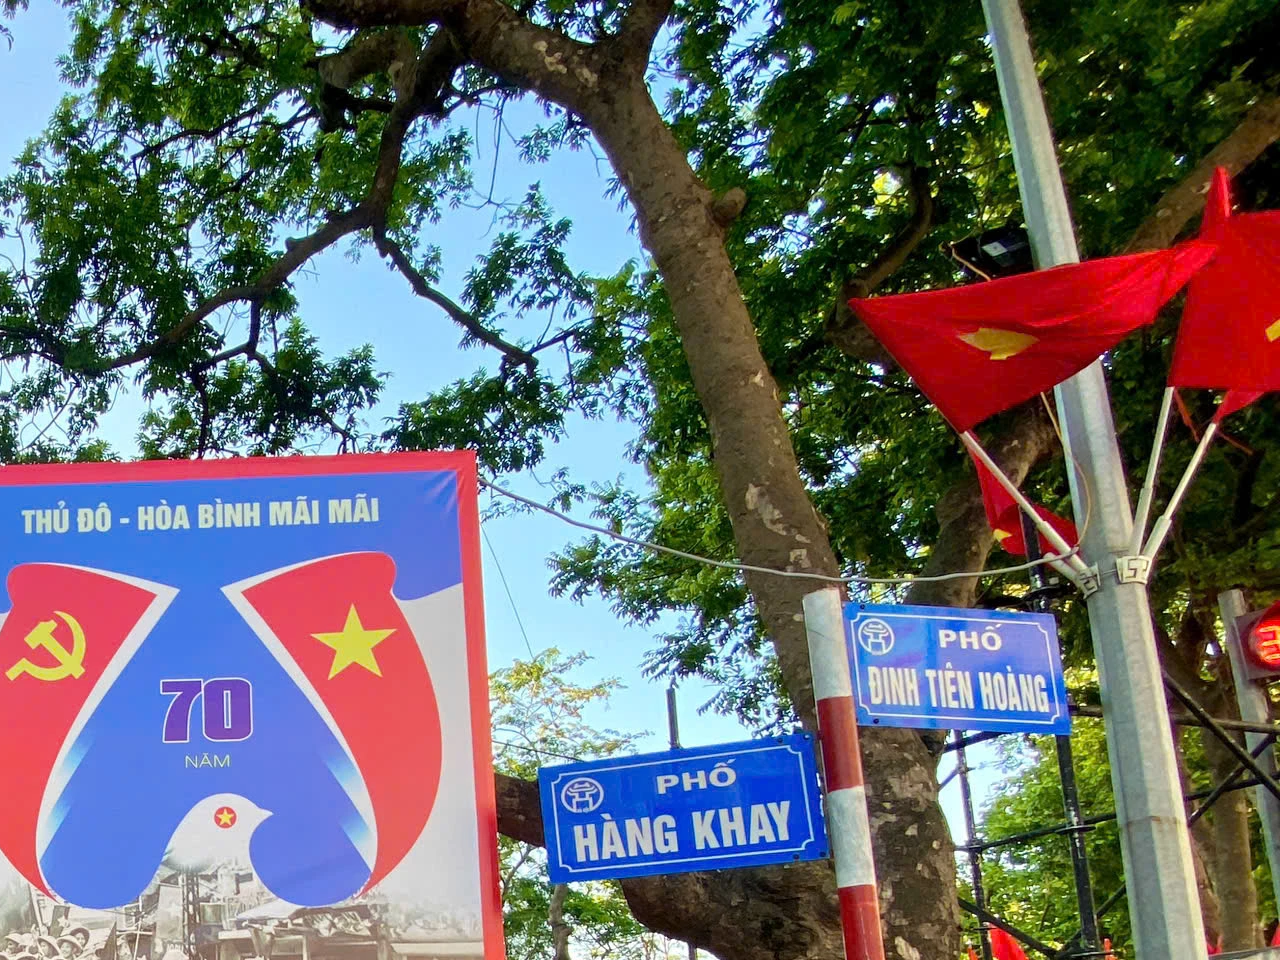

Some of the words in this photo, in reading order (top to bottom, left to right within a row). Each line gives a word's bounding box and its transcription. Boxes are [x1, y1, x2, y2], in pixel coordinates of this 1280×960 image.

[21, 500, 69, 534] THỦ
[77, 502, 112, 532] ĐÔ
[137, 499, 190, 531] HÒA
[198, 498, 261, 528] BÌNH
[269, 495, 320, 526] MÃI
[328, 493, 379, 523] MÃI
[938, 623, 1002, 651] PHỐ
[868, 666, 920, 706] ĐINH
[925, 662, 975, 709] TIÊN
[978, 665, 1050, 713] HOÀNG
[160, 677, 252, 743] 70
[185, 752, 231, 768] NĂM
[656, 758, 737, 795] PHỐ
[573, 813, 679, 863] HÀNG
[692, 800, 791, 850] KHAY
